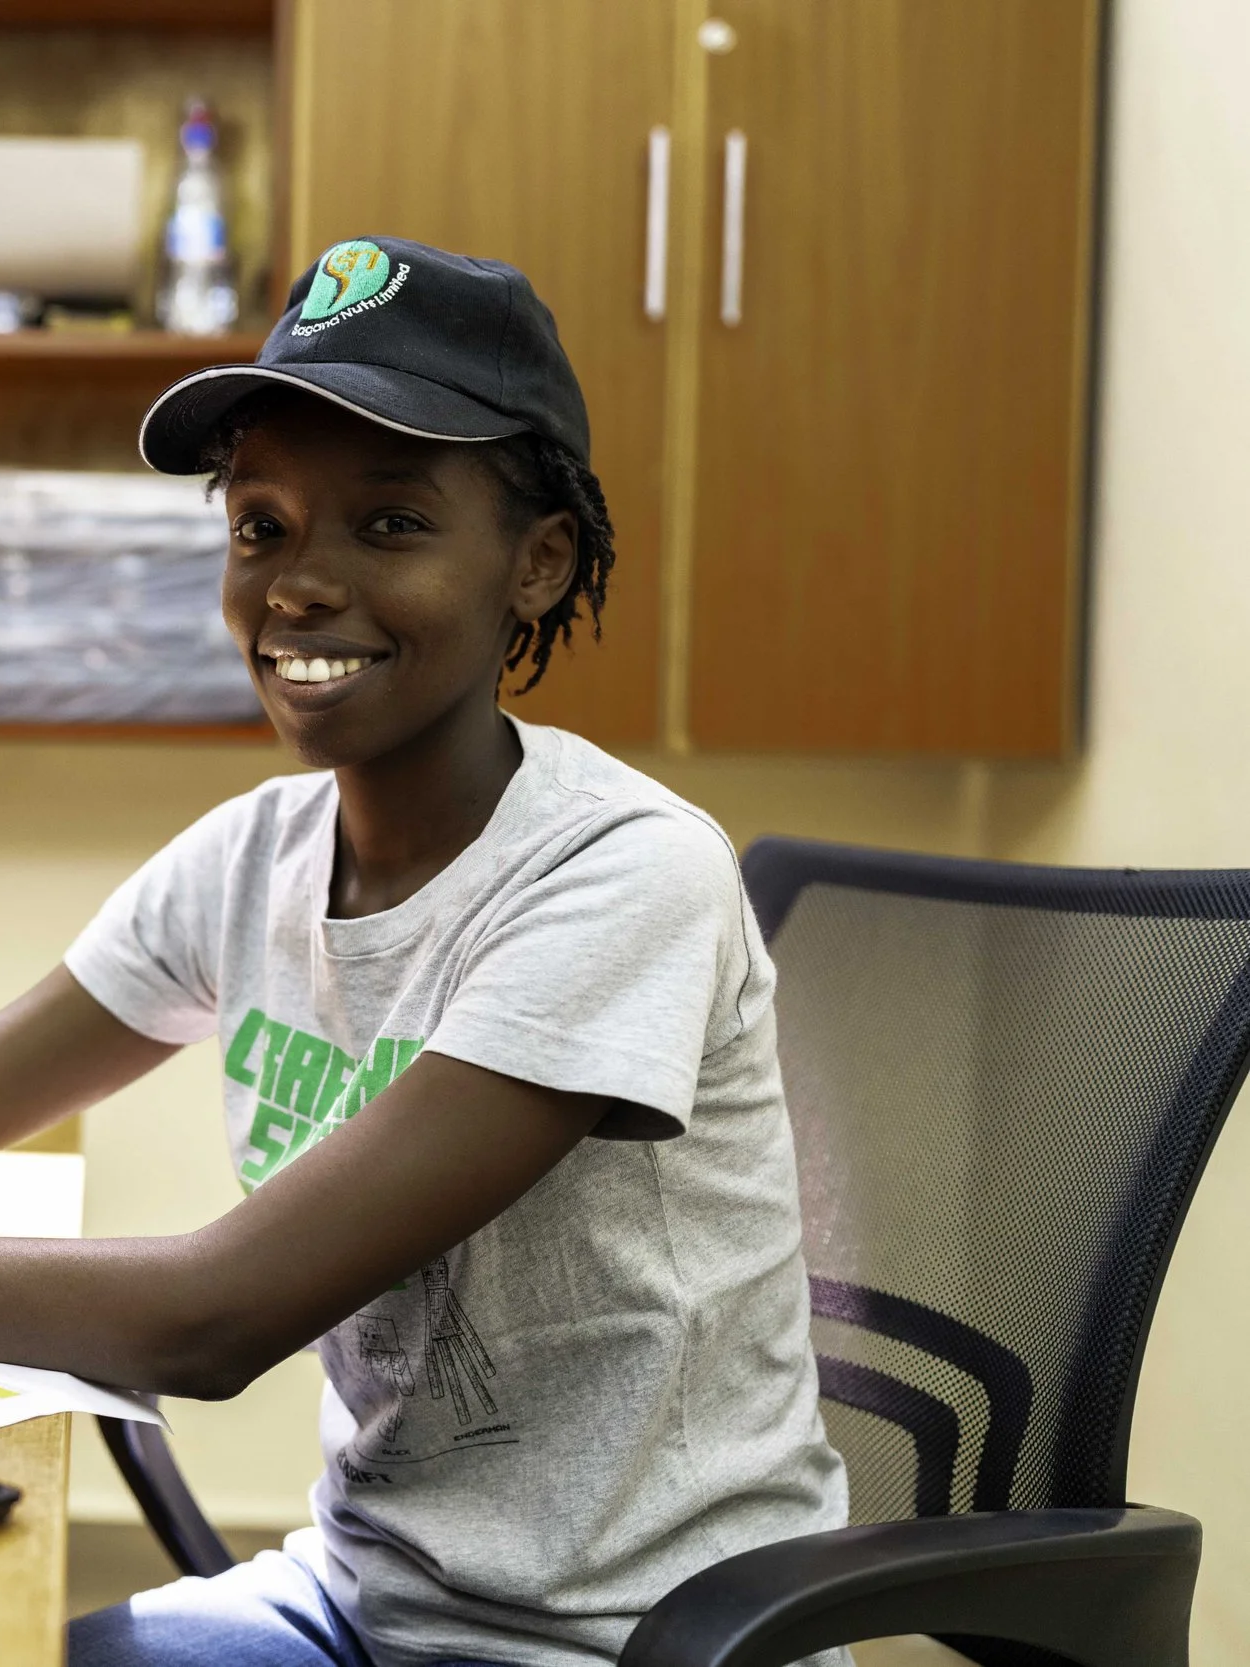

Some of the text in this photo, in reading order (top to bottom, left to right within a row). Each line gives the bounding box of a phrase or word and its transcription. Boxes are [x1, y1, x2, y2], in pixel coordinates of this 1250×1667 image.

[291, 263, 411, 337] Sagana Nuts Limited
